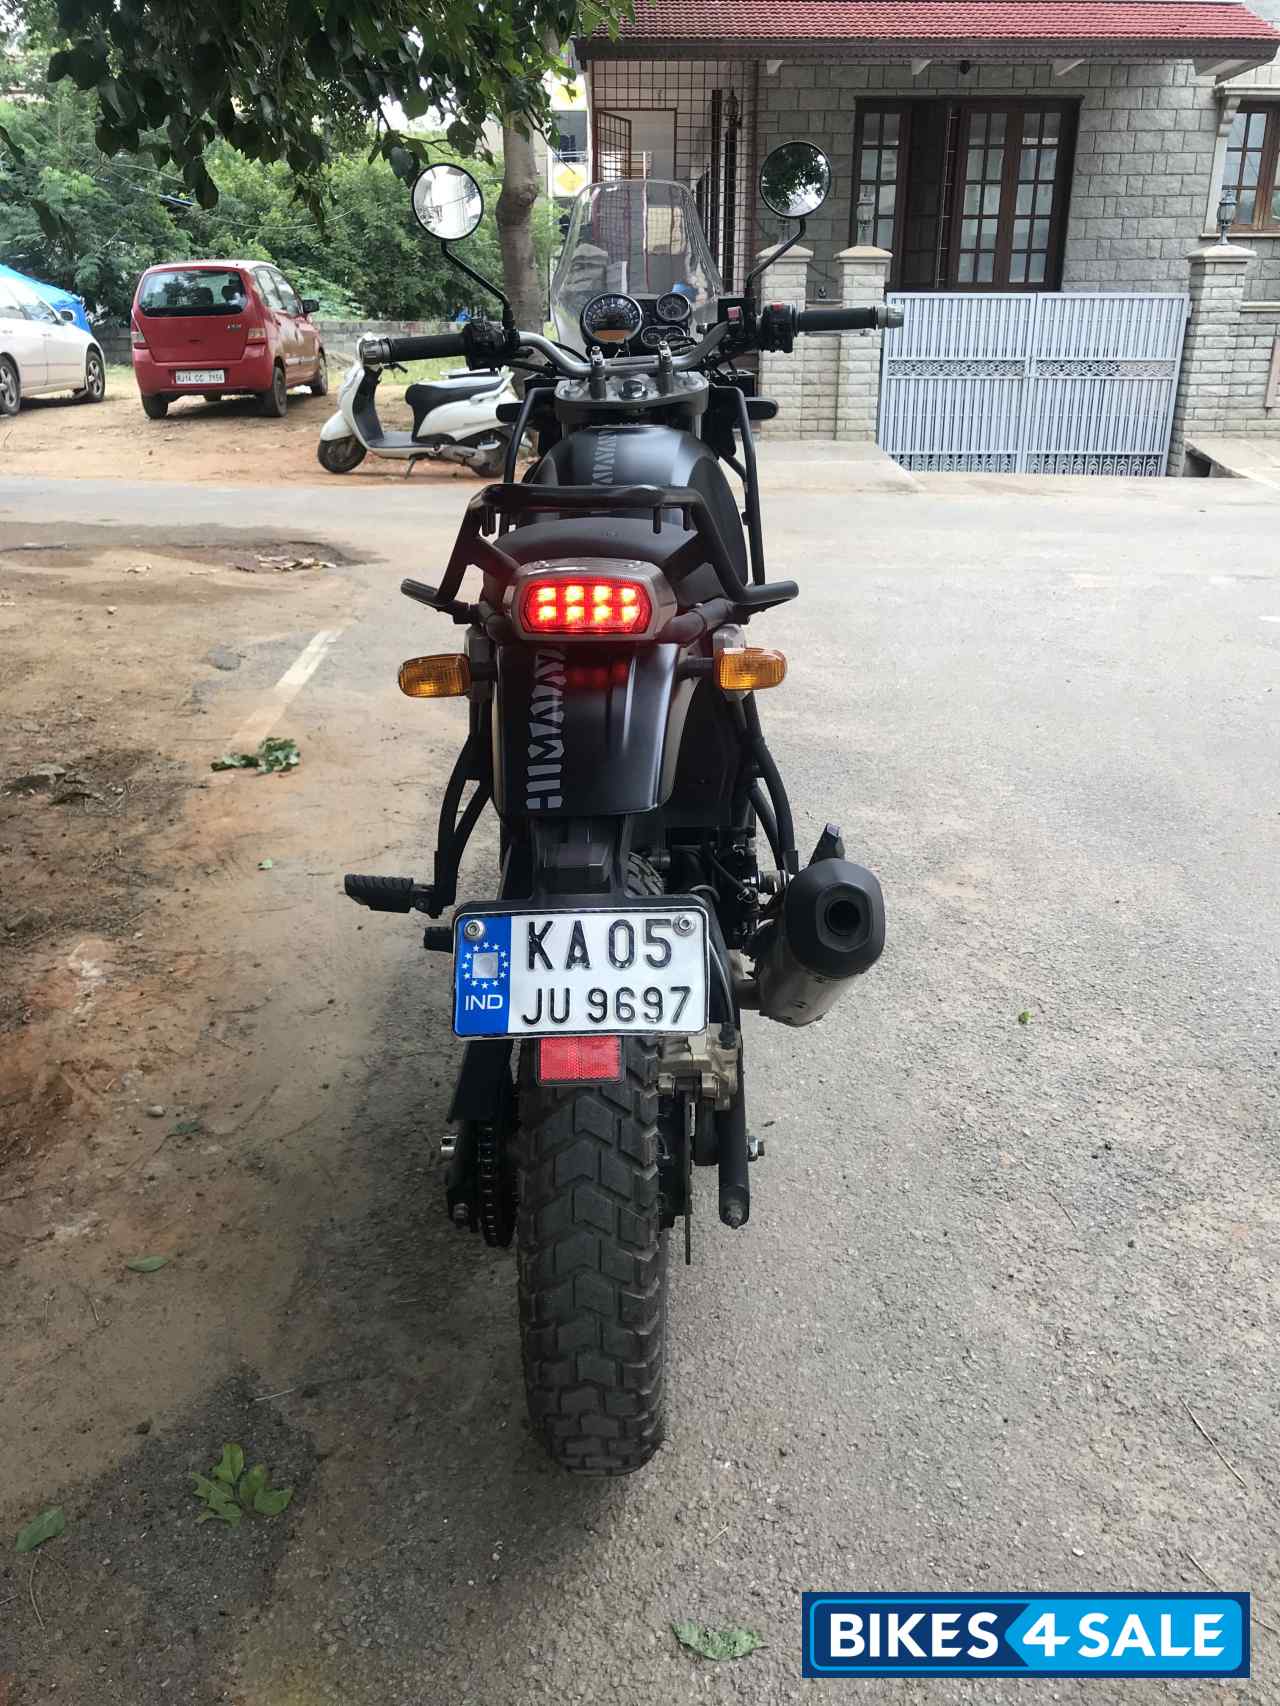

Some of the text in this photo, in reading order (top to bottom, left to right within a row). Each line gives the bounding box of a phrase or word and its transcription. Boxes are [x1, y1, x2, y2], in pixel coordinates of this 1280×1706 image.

[528, 918, 673, 970] KA 05
[465, 994, 504, 1011] IND
[521, 985, 691, 1025] JU 9697
